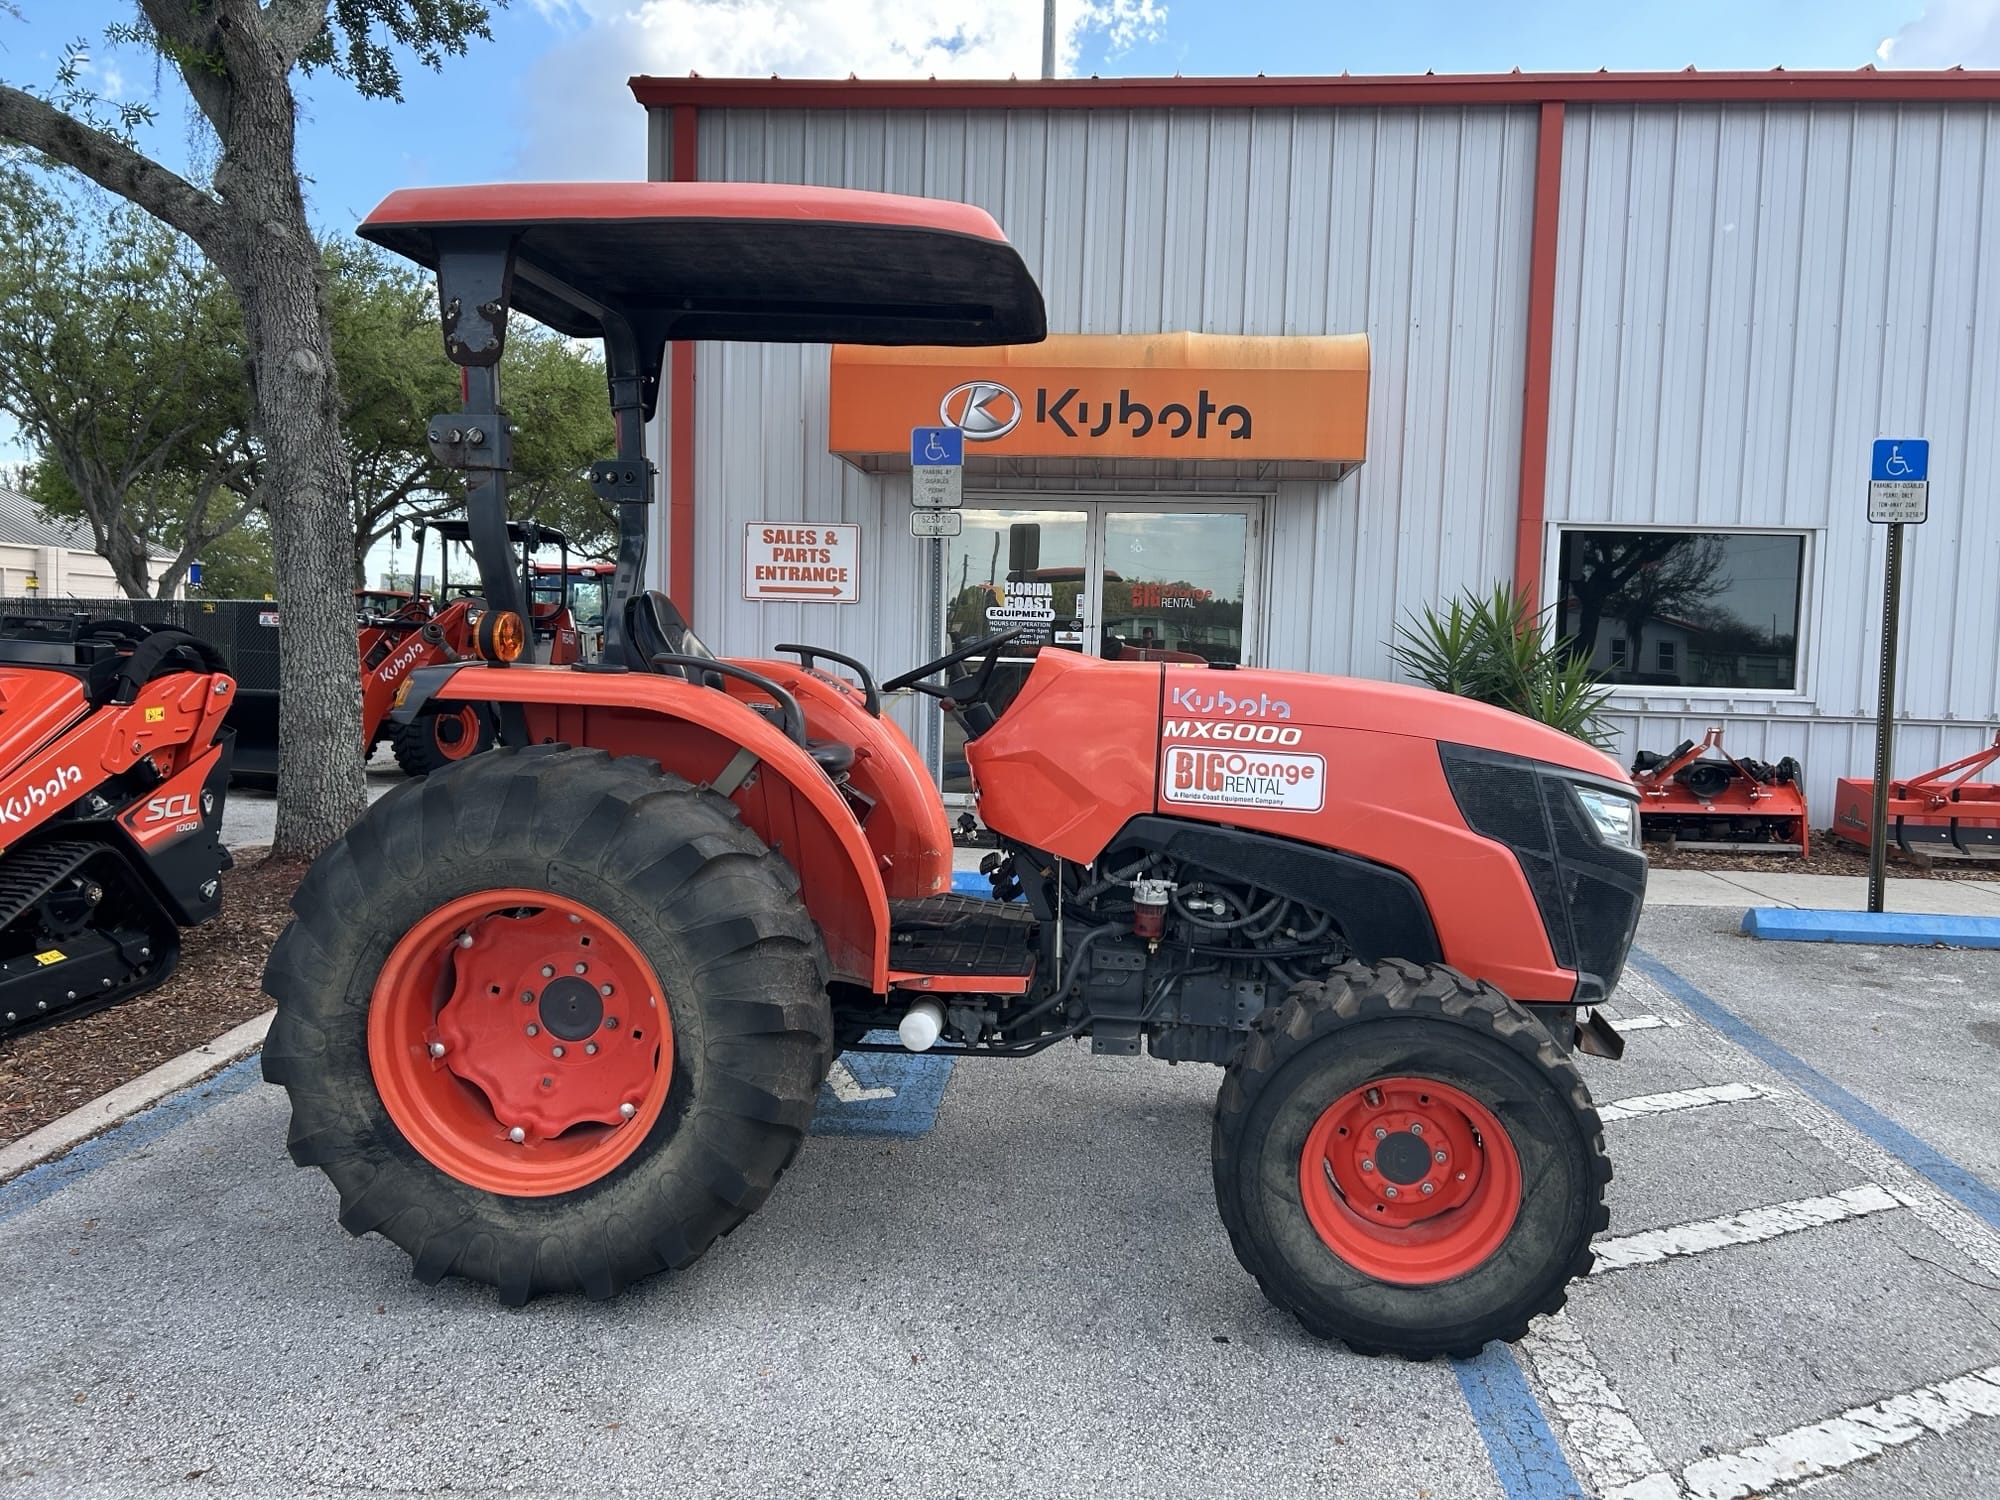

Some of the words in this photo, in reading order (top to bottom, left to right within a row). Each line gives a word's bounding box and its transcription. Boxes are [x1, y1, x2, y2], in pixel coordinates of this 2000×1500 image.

[1036, 388, 1252, 439] Kubota
[762, 529, 817, 545] SALES
[824, 531, 839, 545] &
[772, 547, 831, 563] PARTS
[755, 565, 848, 583] ENTRANCE
[1004, 582, 1053, 596] FLORIDA
[1161, 585, 1214, 602] Orange
[1005, 596, 1053, 609] COAST
[1161, 597, 1196, 609] RENTAL
[989, 609, 1052, 618] EQUIPMENT
[378, 642, 425, 683] Kubota
[1172, 687, 1292, 719] Kubota
[1163, 720, 1303, 746] MX6000
[1174, 751, 1225, 792] BIG
[1225, 754, 1315, 786] Orange
[1224, 775, 1286, 796] RENTAL
[0, 765, 83, 825] Kubota
[1202, 793, 1220, 801] Coast
[1221, 795, 1254, 804] Equipment
[1255, 797, 1284, 806] Company
[145, 794, 198, 822] SCL
[175, 821, 198, 832] 1000
